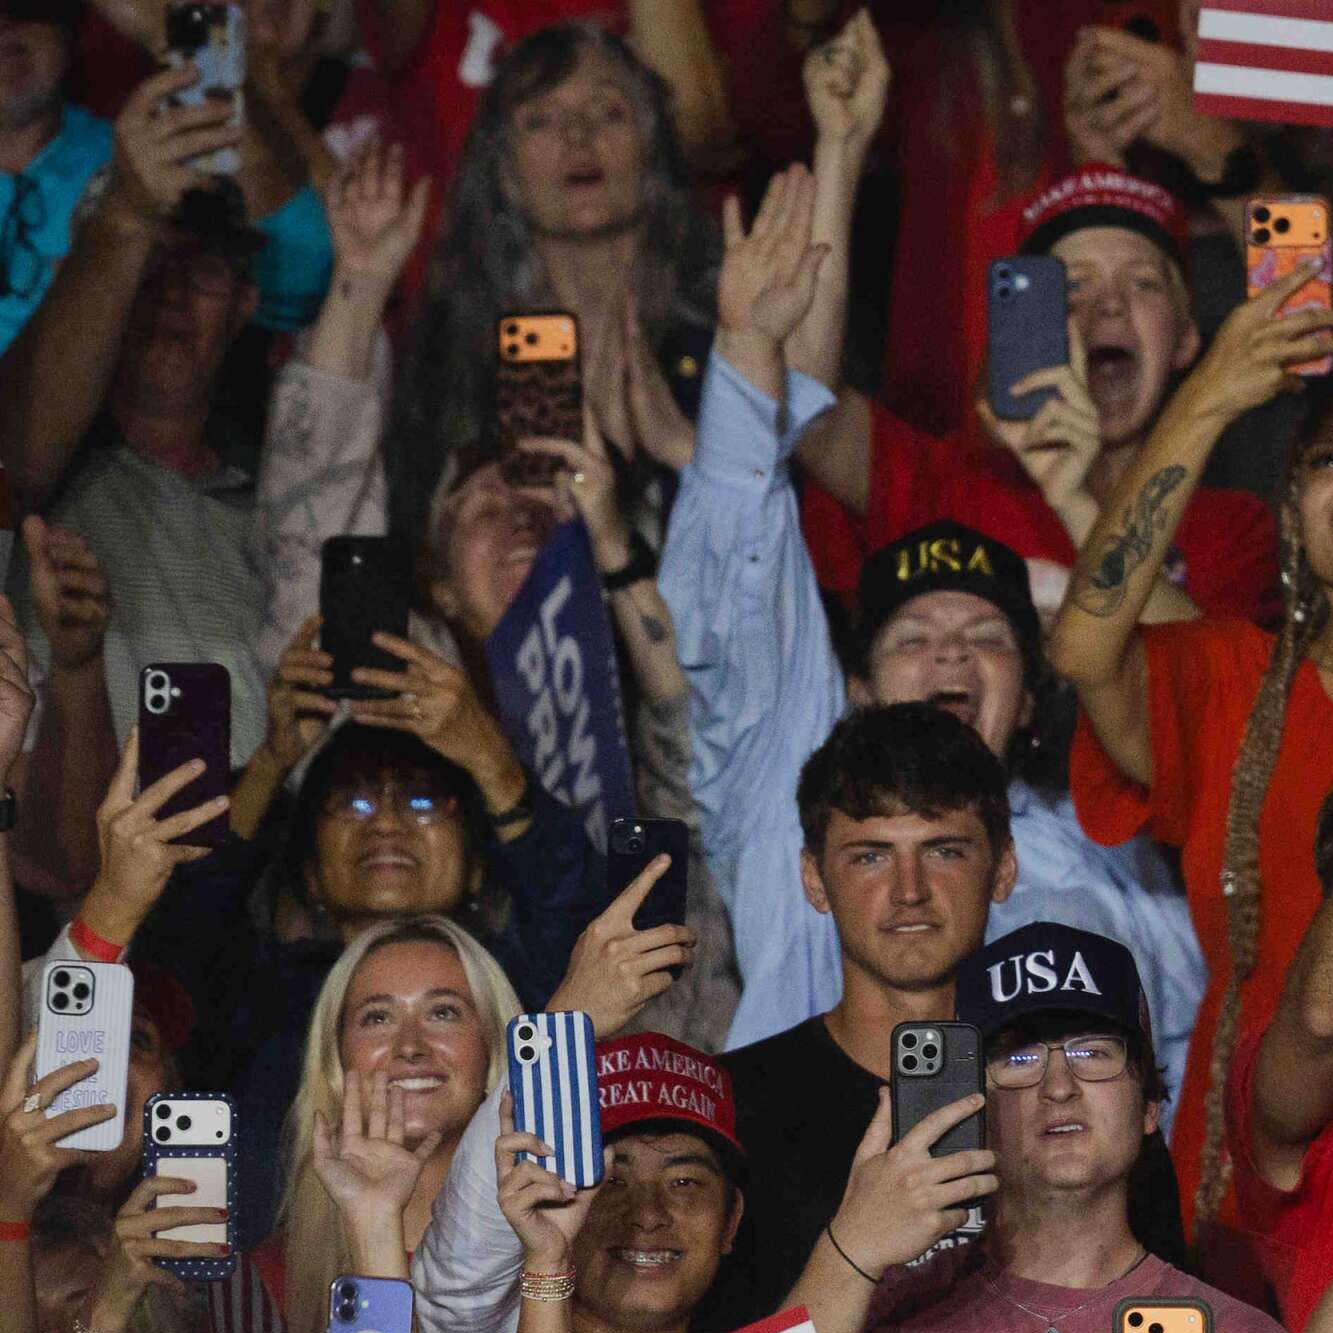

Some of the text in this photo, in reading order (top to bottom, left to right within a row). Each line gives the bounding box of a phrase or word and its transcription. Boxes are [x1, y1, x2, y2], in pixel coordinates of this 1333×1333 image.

[896, 537, 993, 581] USA
[986, 949, 1103, 1002] USA
[55, 1030, 105, 1054] LOVE
[597, 1046, 725, 1099] KE AMERICA
[598, 1080, 716, 1122] REAT AGAIN
